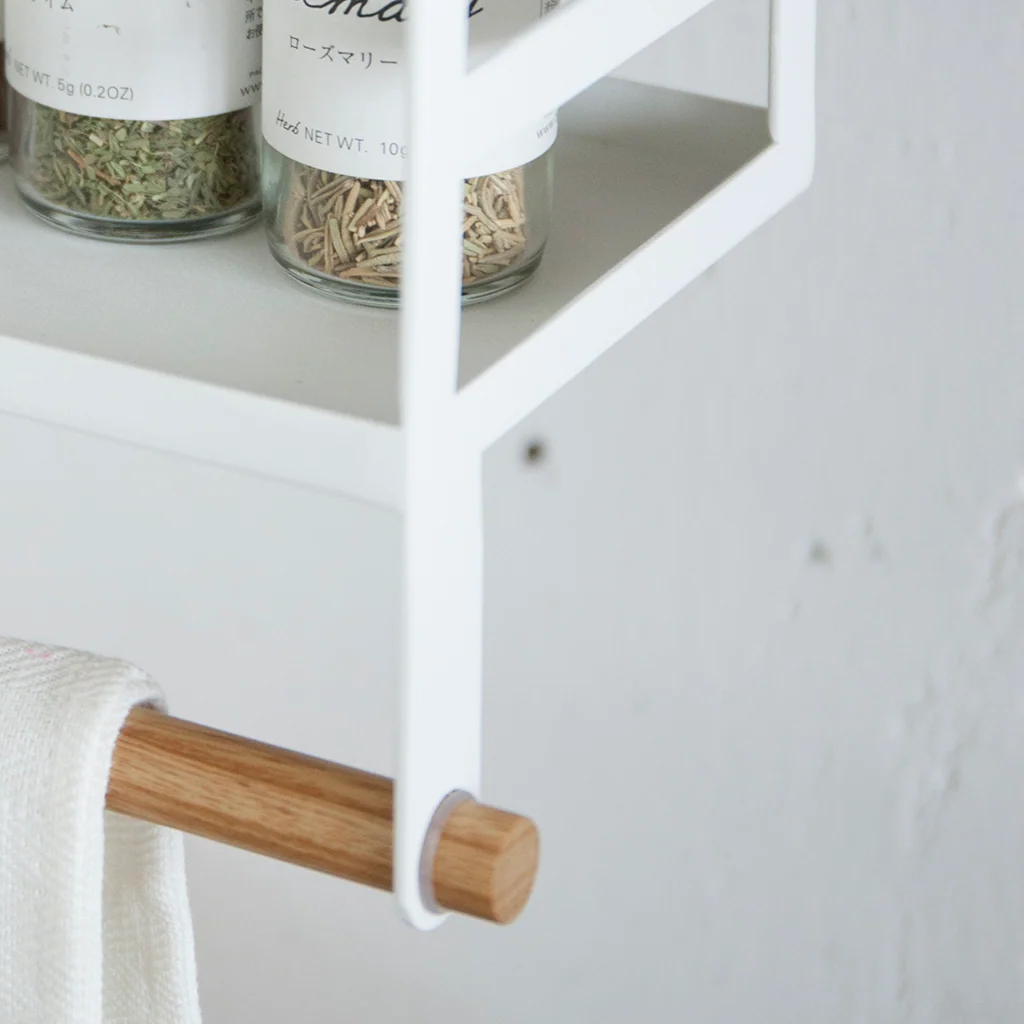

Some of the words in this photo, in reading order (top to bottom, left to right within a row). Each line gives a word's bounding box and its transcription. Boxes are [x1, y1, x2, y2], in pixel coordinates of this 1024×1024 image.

[289, 34, 399, 70] ローズマリー
[57, 77, 75, 97] 5g
[275, 109, 302, 136] Herb
[304, 126, 333, 147] NET
[337, 135, 368, 154] WT.
